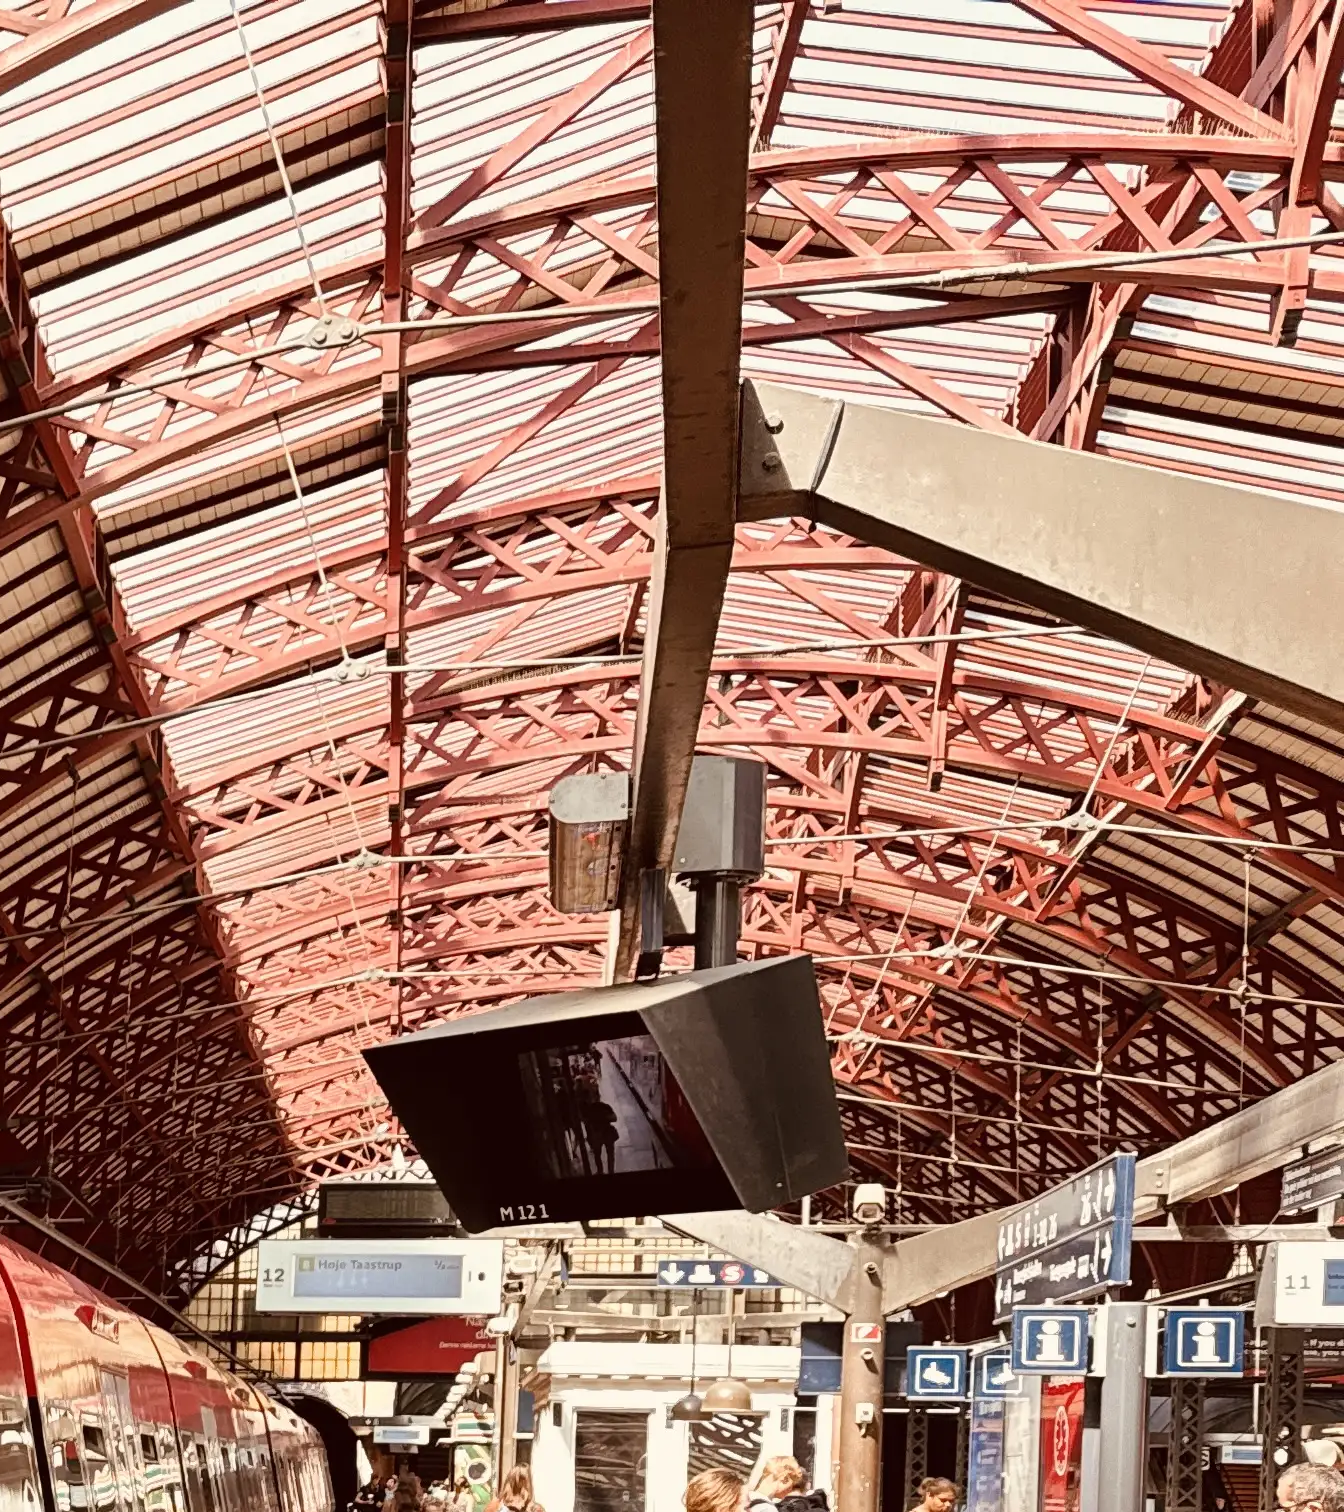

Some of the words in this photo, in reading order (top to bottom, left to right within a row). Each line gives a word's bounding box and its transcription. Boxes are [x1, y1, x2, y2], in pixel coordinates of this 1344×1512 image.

[499, 1206, 514, 1221] M
[517, 1203, 550, 1220] 121
[350, 1259, 402, 1272] Taastrup
[262, 1268, 285, 1283] 12
[1284, 1274, 1311, 1290] 11
